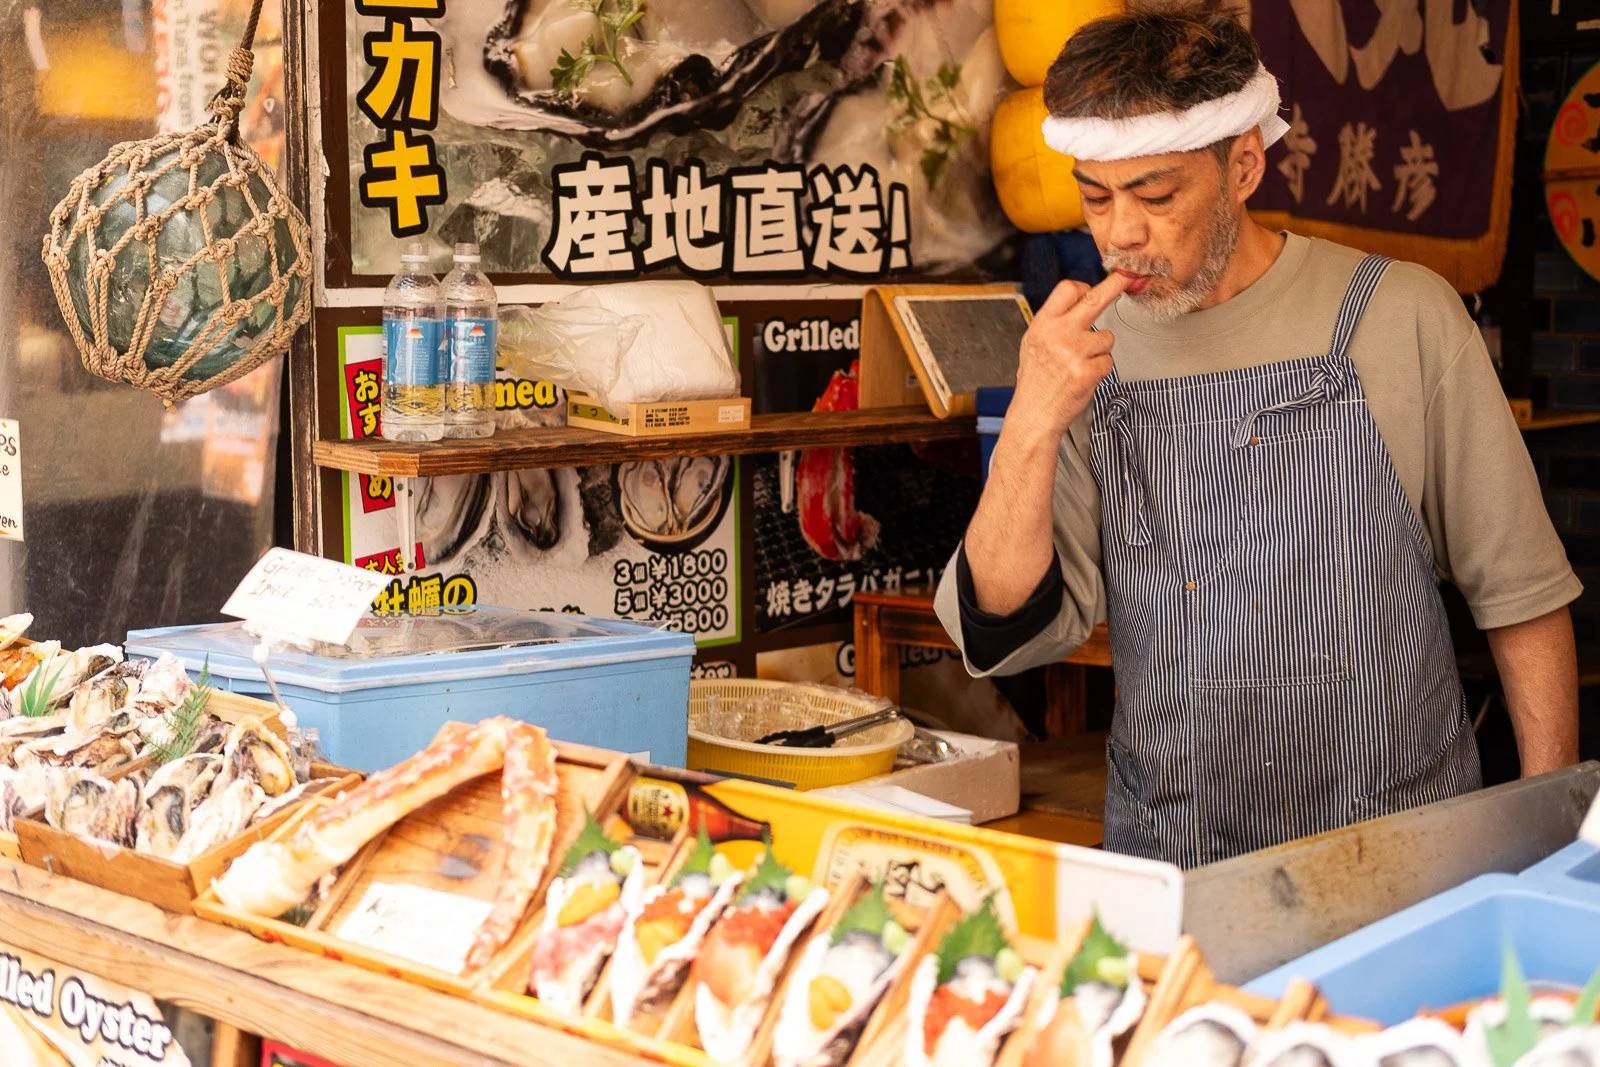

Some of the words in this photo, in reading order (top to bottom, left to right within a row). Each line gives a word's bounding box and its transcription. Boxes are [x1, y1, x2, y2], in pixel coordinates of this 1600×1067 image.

[358, 0, 446, 236] カキ
[543, 154, 910, 278] 産地直送!
[763, 319, 860, 353] Grilled
[0, 952, 55, 1018] lled
[60, 976, 173, 1061] Oyster
